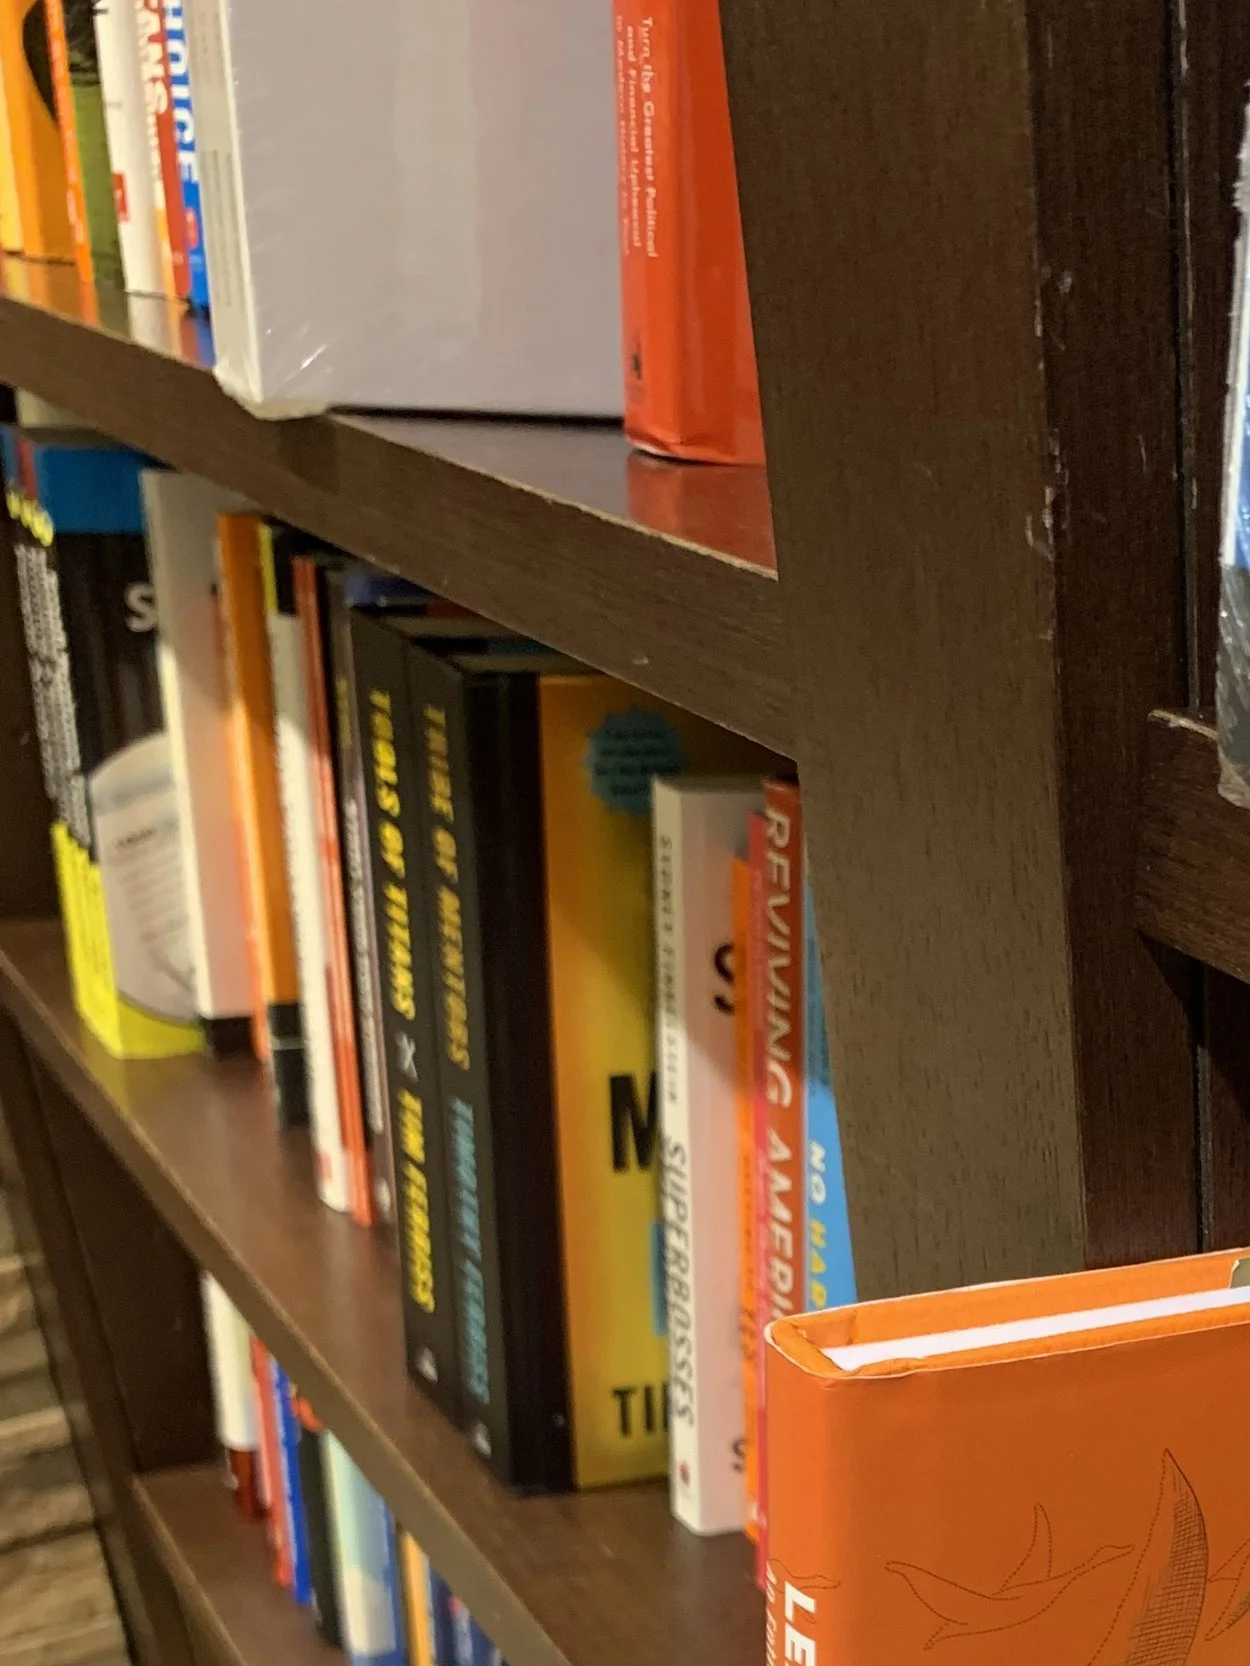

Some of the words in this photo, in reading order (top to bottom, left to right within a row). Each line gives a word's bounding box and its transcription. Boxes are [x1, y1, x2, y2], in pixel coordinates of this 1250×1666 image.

[627, 25, 637, 62] and
[641, 64, 655, 93] the
[643, 101, 656, 181] Greatest
[645, 187, 658, 257] Political
[379, 819, 406, 880] OF
[431, 824, 459, 885] OF
[764, 804, 792, 1109] REVIVING
[809, 1140, 826, 1205] NO
[766, 1128, 794, 1319] AMERI
[663, 1135, 695, 1428] SUPERBOSSES
